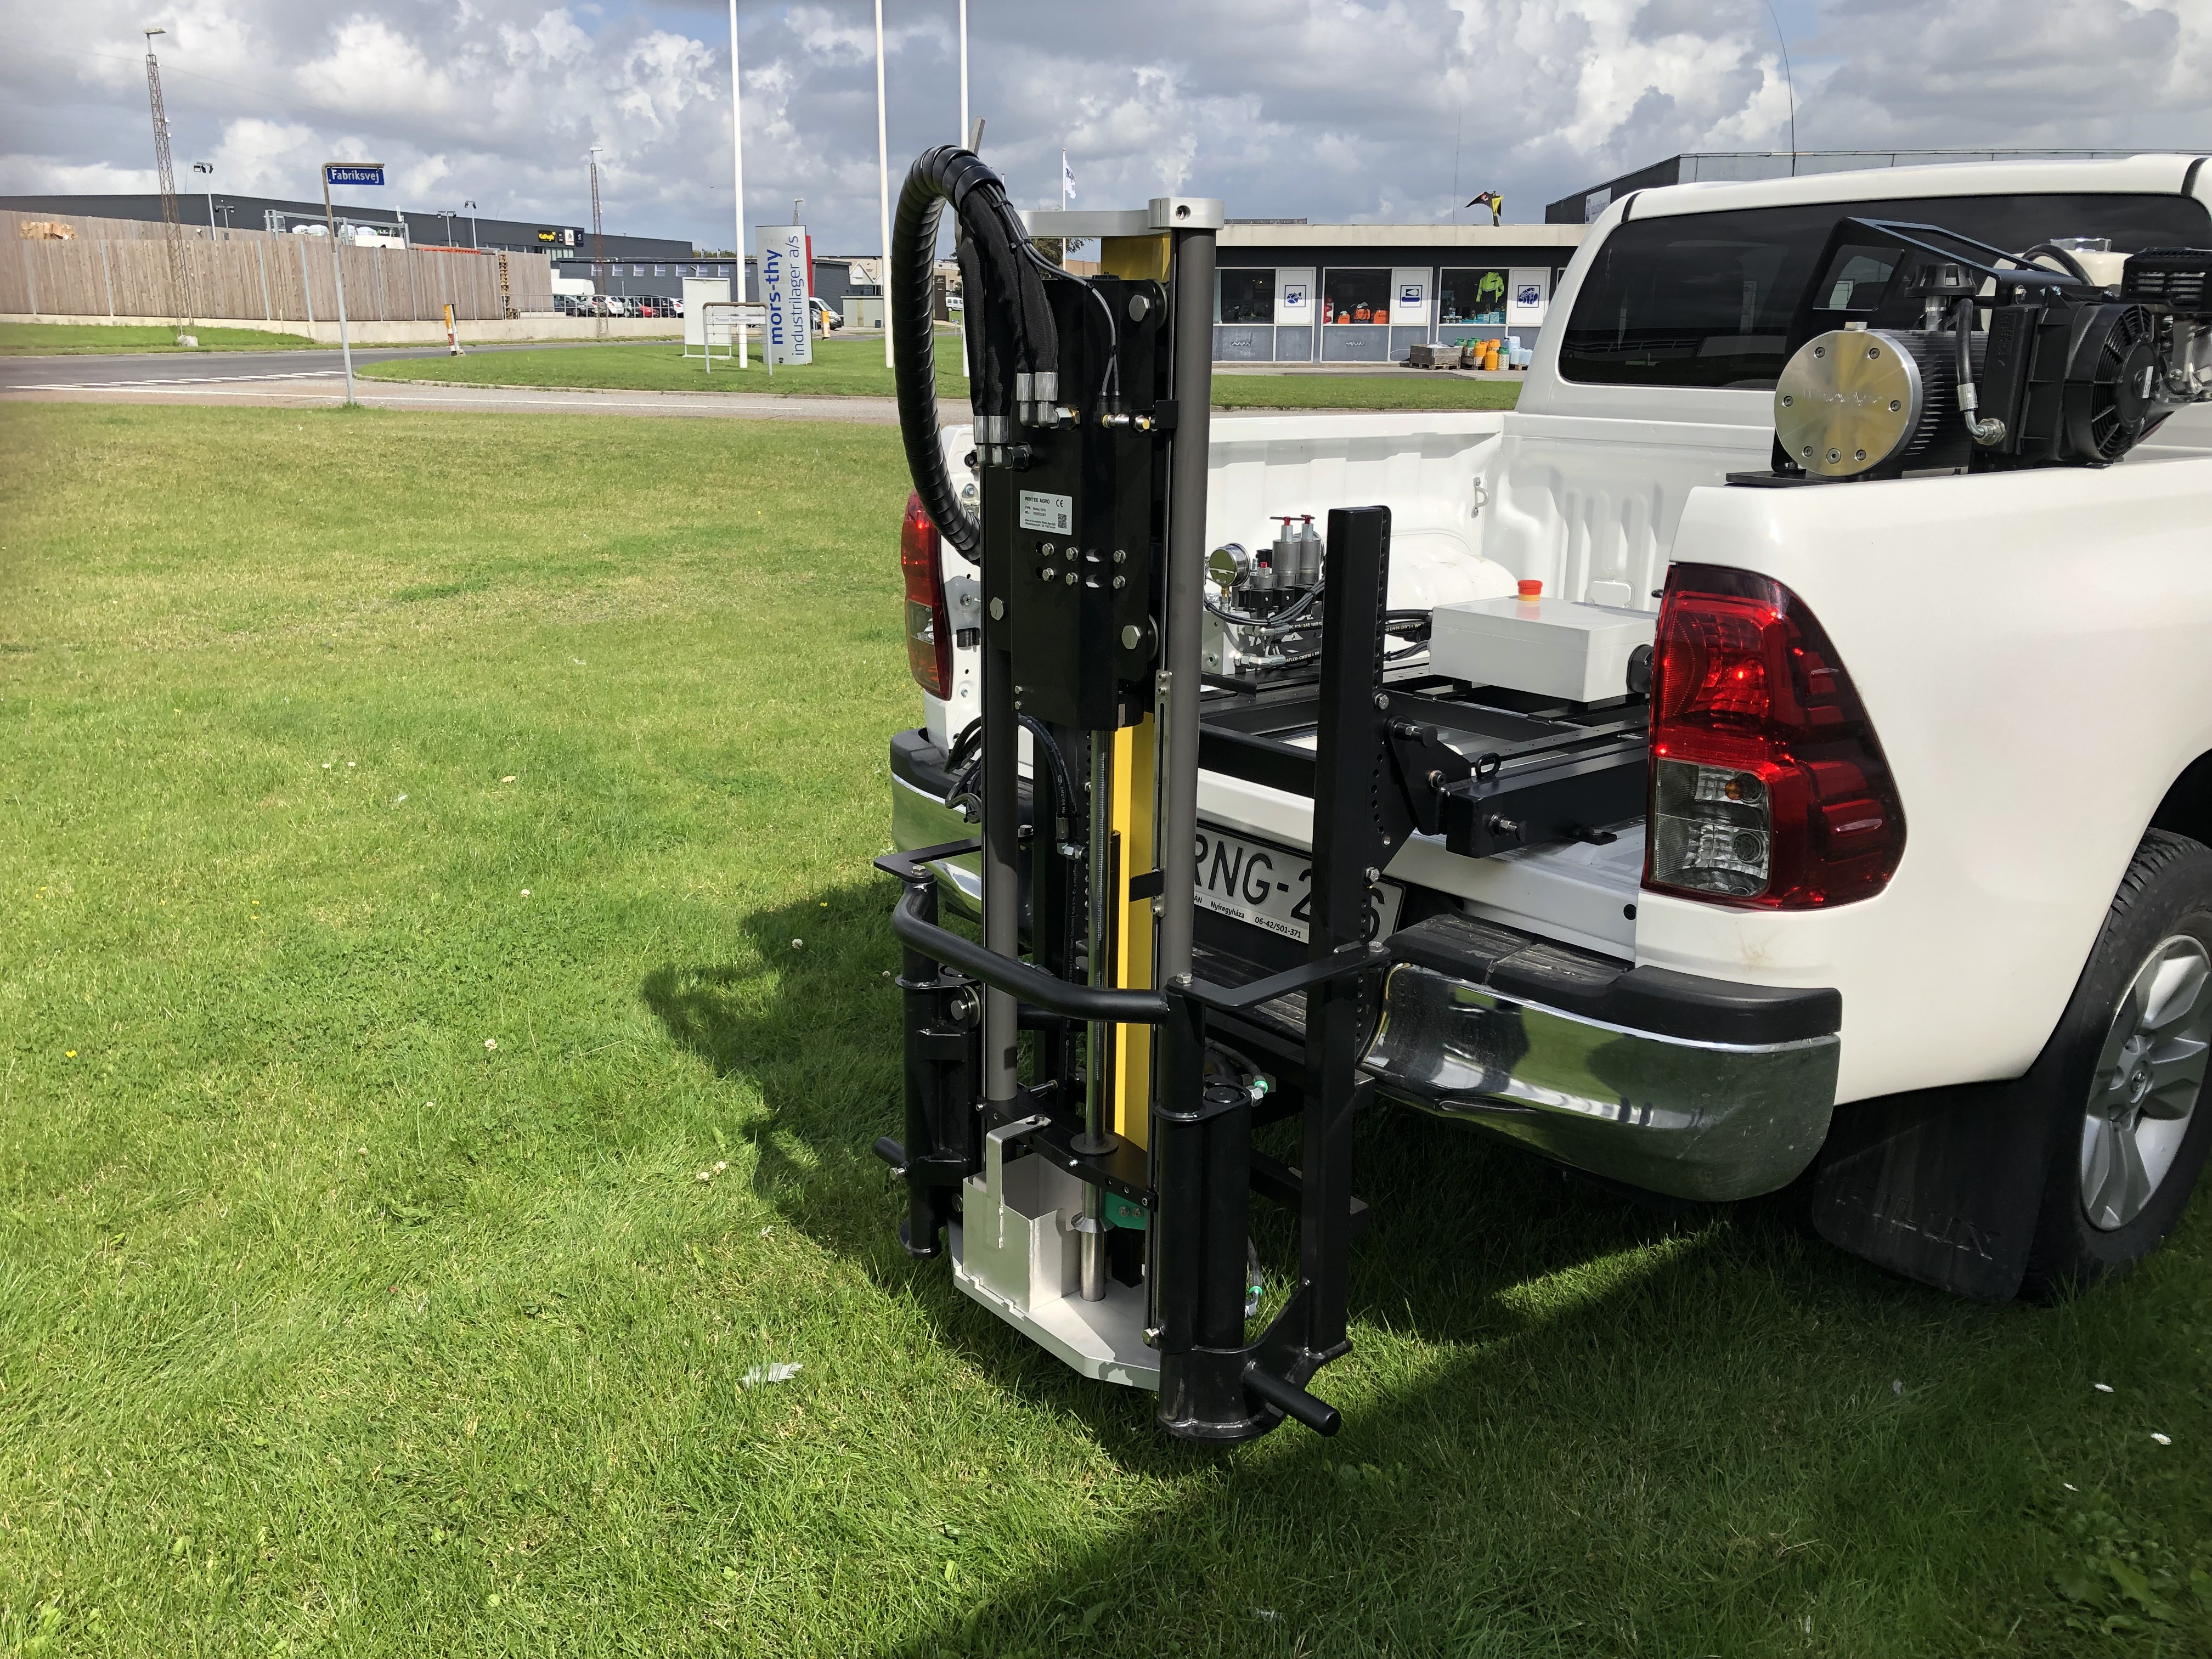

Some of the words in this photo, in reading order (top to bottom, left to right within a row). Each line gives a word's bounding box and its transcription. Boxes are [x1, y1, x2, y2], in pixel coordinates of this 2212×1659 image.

[331, 169, 379, 184] Fabriksvej
[785, 235, 800, 258] a/s
[763, 249, 783, 345] mors-thy
[788, 263, 805, 356] industrilager
[1210, 900, 1245, 919] Nyíregyháza
[1255, 916, 1302, 939] 06-42/501-371
